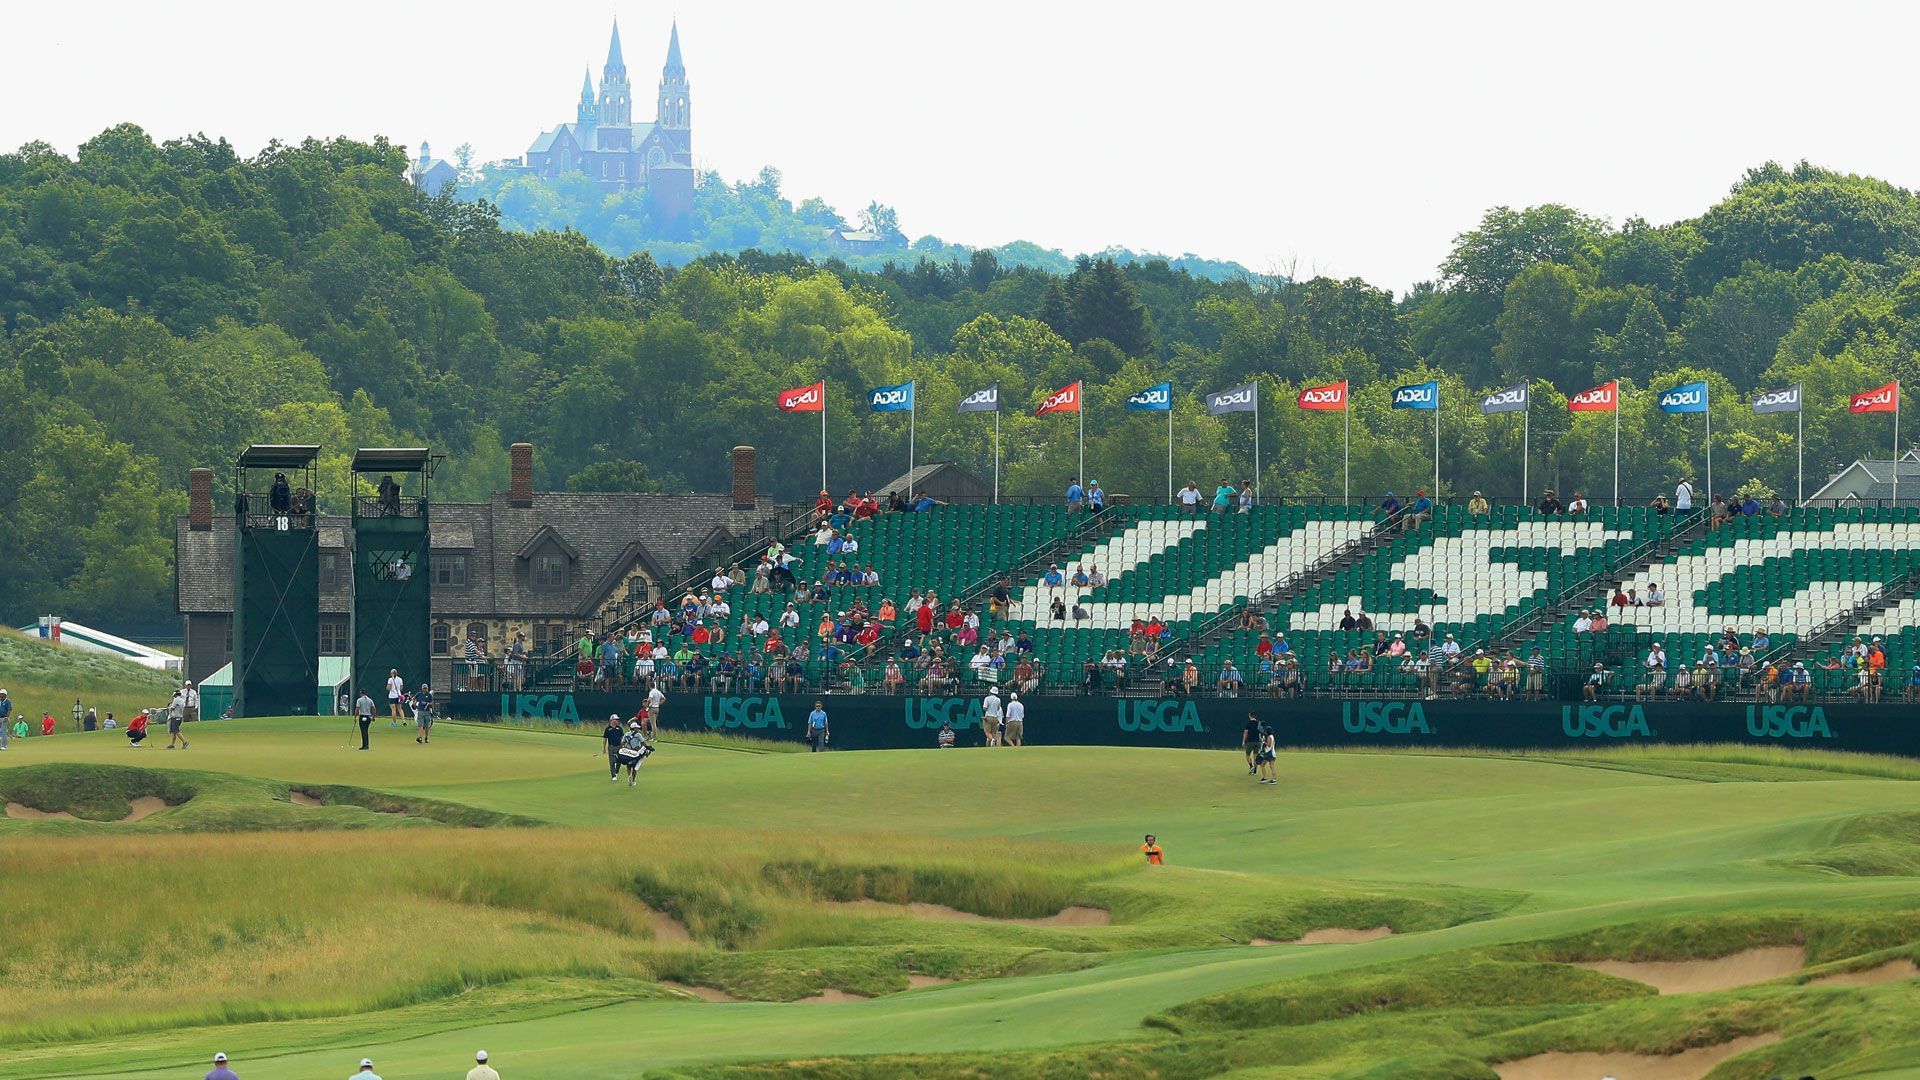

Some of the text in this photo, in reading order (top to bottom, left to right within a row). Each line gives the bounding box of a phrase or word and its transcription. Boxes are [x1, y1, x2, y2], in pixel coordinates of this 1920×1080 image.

[276, 516, 289, 531] 18
[1009, 519, 1920, 642] USG
[501, 694, 580, 725] USGA
[704, 696, 786, 729] USGA
[904, 697, 984, 729] USGA
[1117, 699, 1203, 732] USGA
[1342, 701, 1430, 734] USGA
[1562, 705, 1651, 737] USGA
[1746, 704, 1831, 738] USGA
